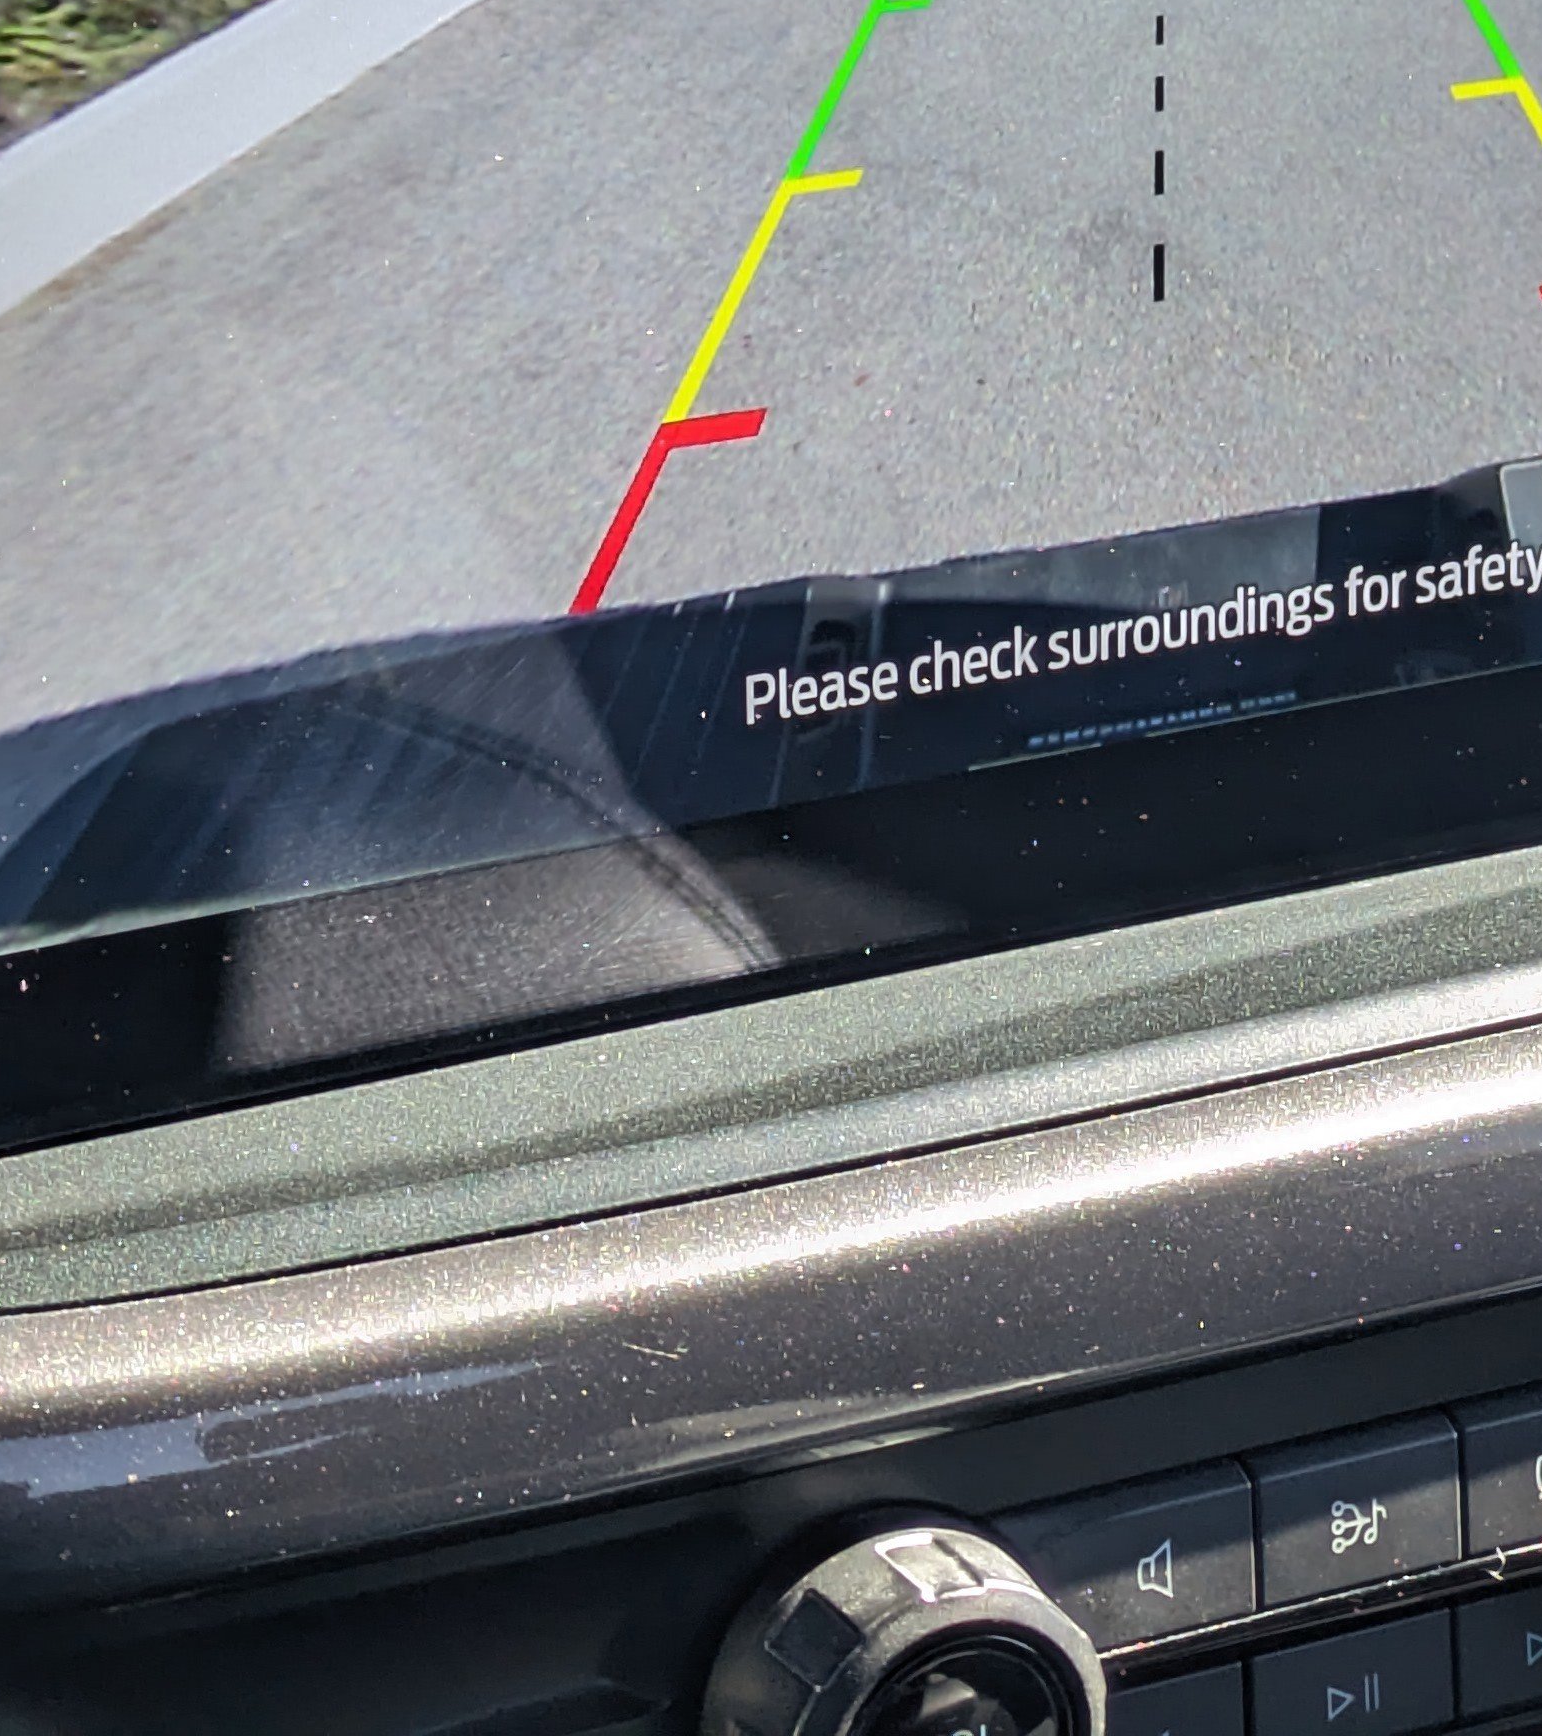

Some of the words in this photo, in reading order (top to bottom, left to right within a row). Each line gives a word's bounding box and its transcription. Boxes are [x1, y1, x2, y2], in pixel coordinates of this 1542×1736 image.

[745, 660, 899, 726] Please
[908, 625, 1039, 695] check
[1047, 583, 1335, 671] surroundings
[1344, 564, 1408, 617] for
